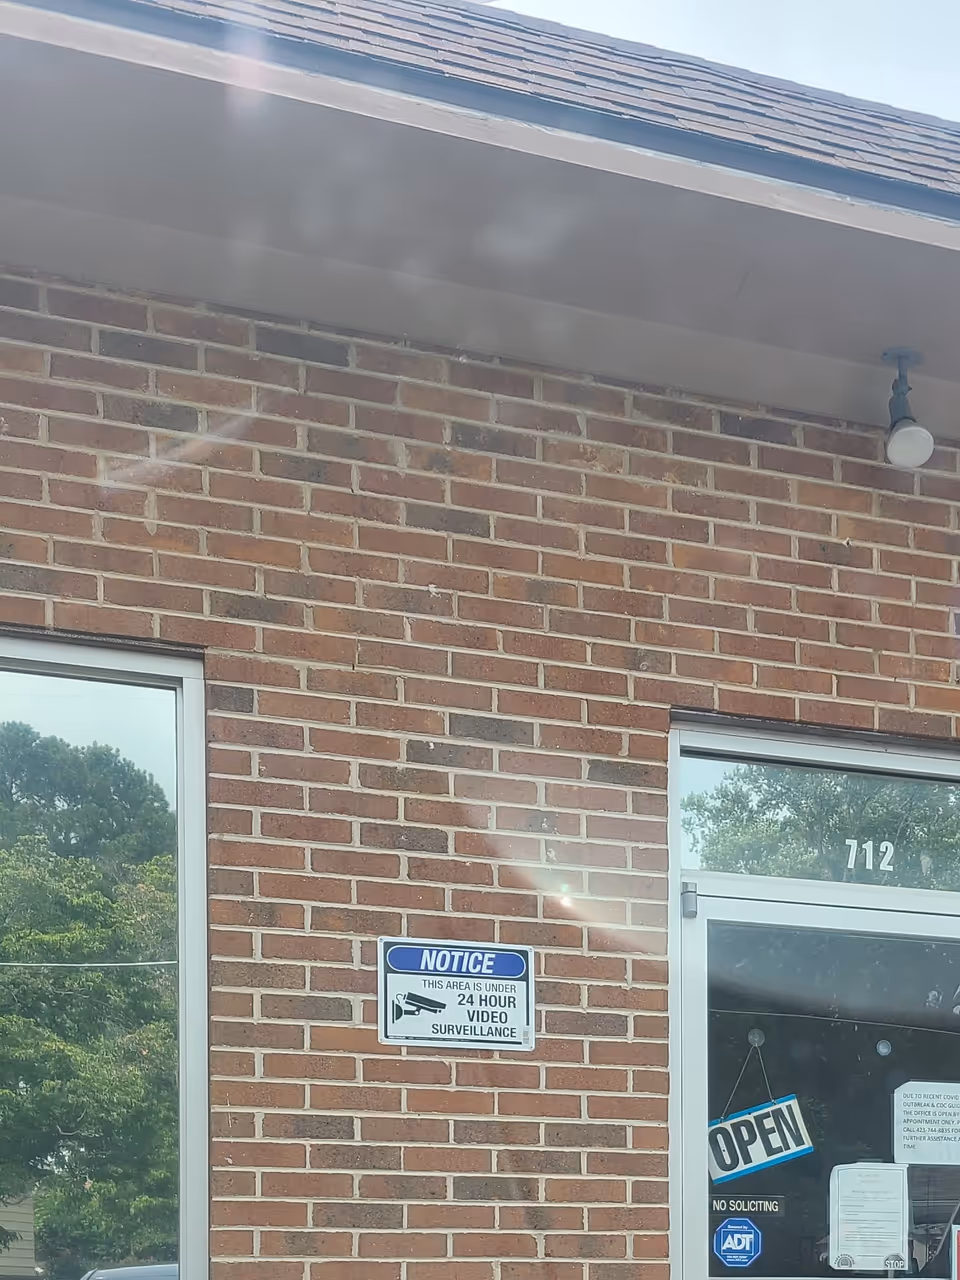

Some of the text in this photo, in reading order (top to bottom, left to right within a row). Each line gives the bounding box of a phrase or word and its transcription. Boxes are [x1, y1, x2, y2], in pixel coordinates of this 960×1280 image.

[845, 838, 895, 872] 712
[420, 949, 496, 974] NOTICE
[422, 979, 517, 994] THIS AREA IS UNDER
[457, 993, 517, 1008] 24 HOUR
[467, 1010, 508, 1024] VIDEO
[431, 1024, 517, 1038] SURVEILLANCE
[708, 1104, 806, 1172] OPEN
[713, 1200, 779, 1212] NO SOLICITING
[722, 1233, 754, 1250] ADT
[885, 1260, 905, 1269] STOP
